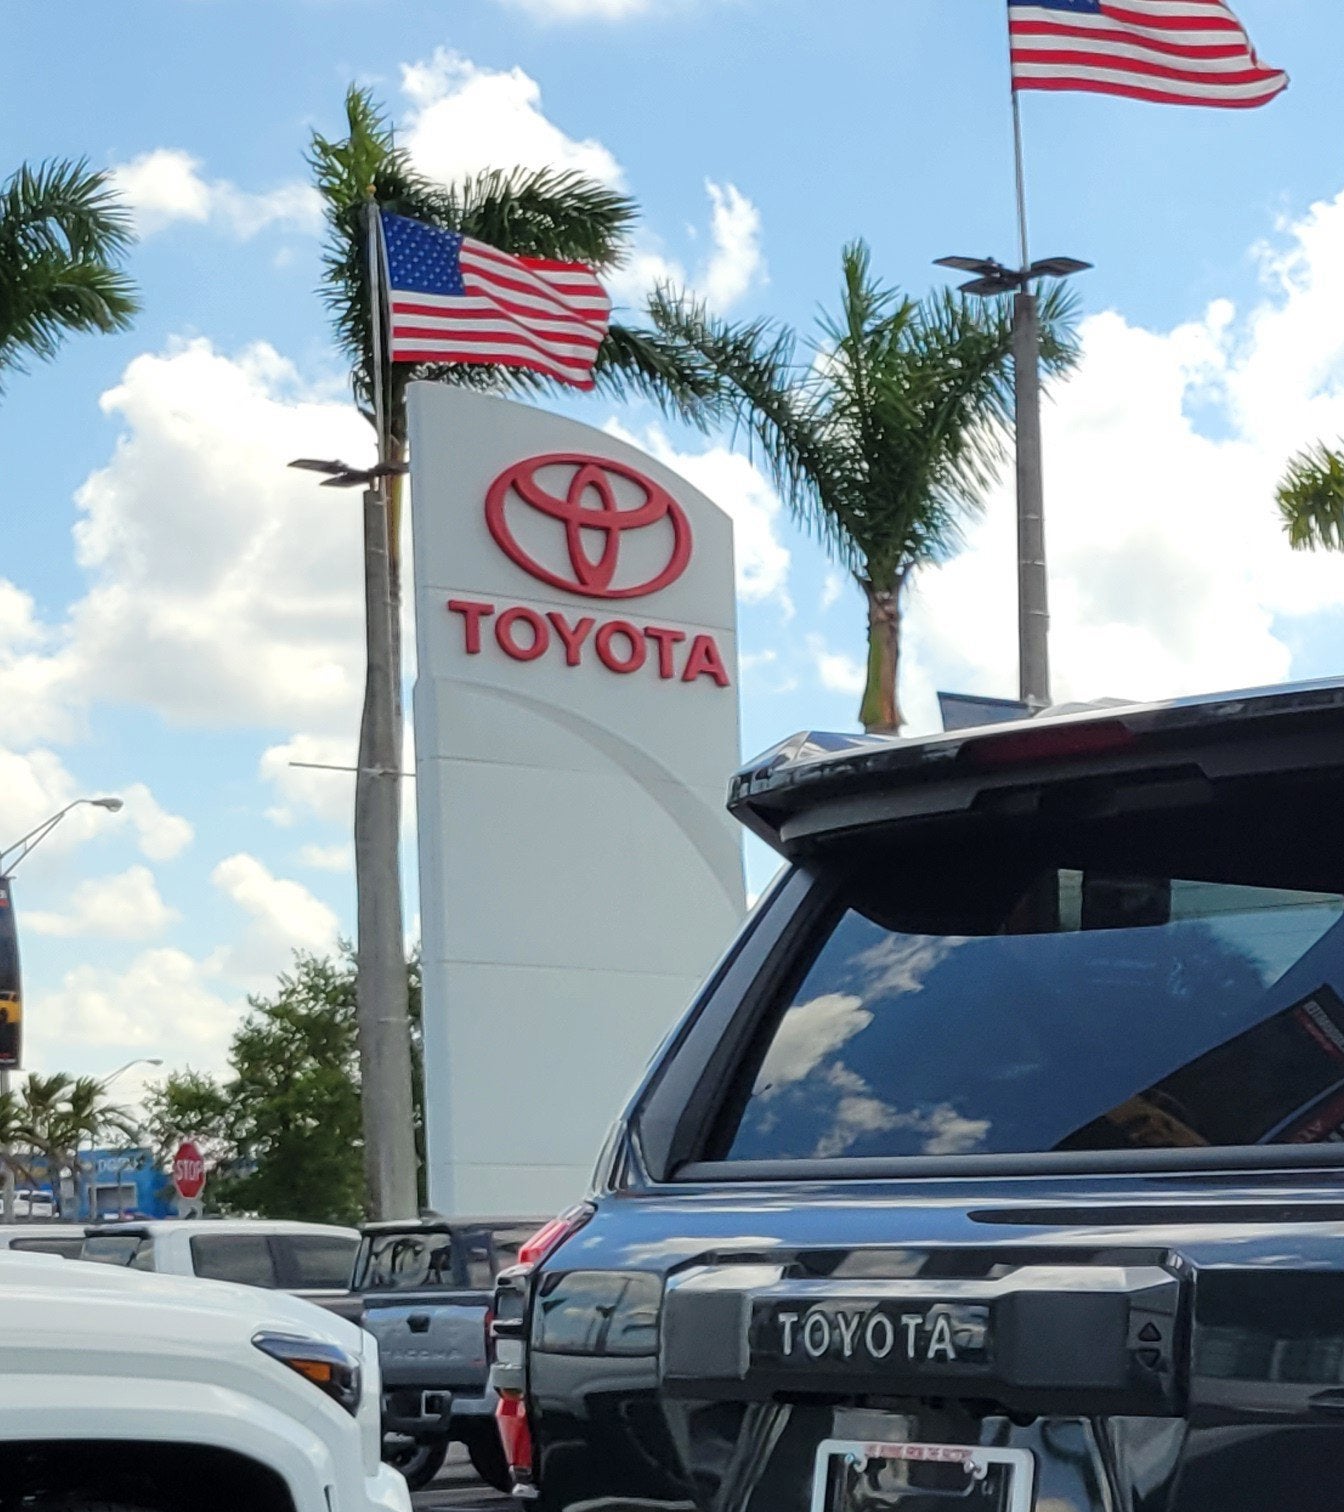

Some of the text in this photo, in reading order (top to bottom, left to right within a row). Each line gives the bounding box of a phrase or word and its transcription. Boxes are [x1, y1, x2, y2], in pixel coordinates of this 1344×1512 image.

[448, 599, 730, 688] TOYOTA
[175, 1158, 202, 1181] STOP
[777, 1311, 959, 1362] TOYOTA
